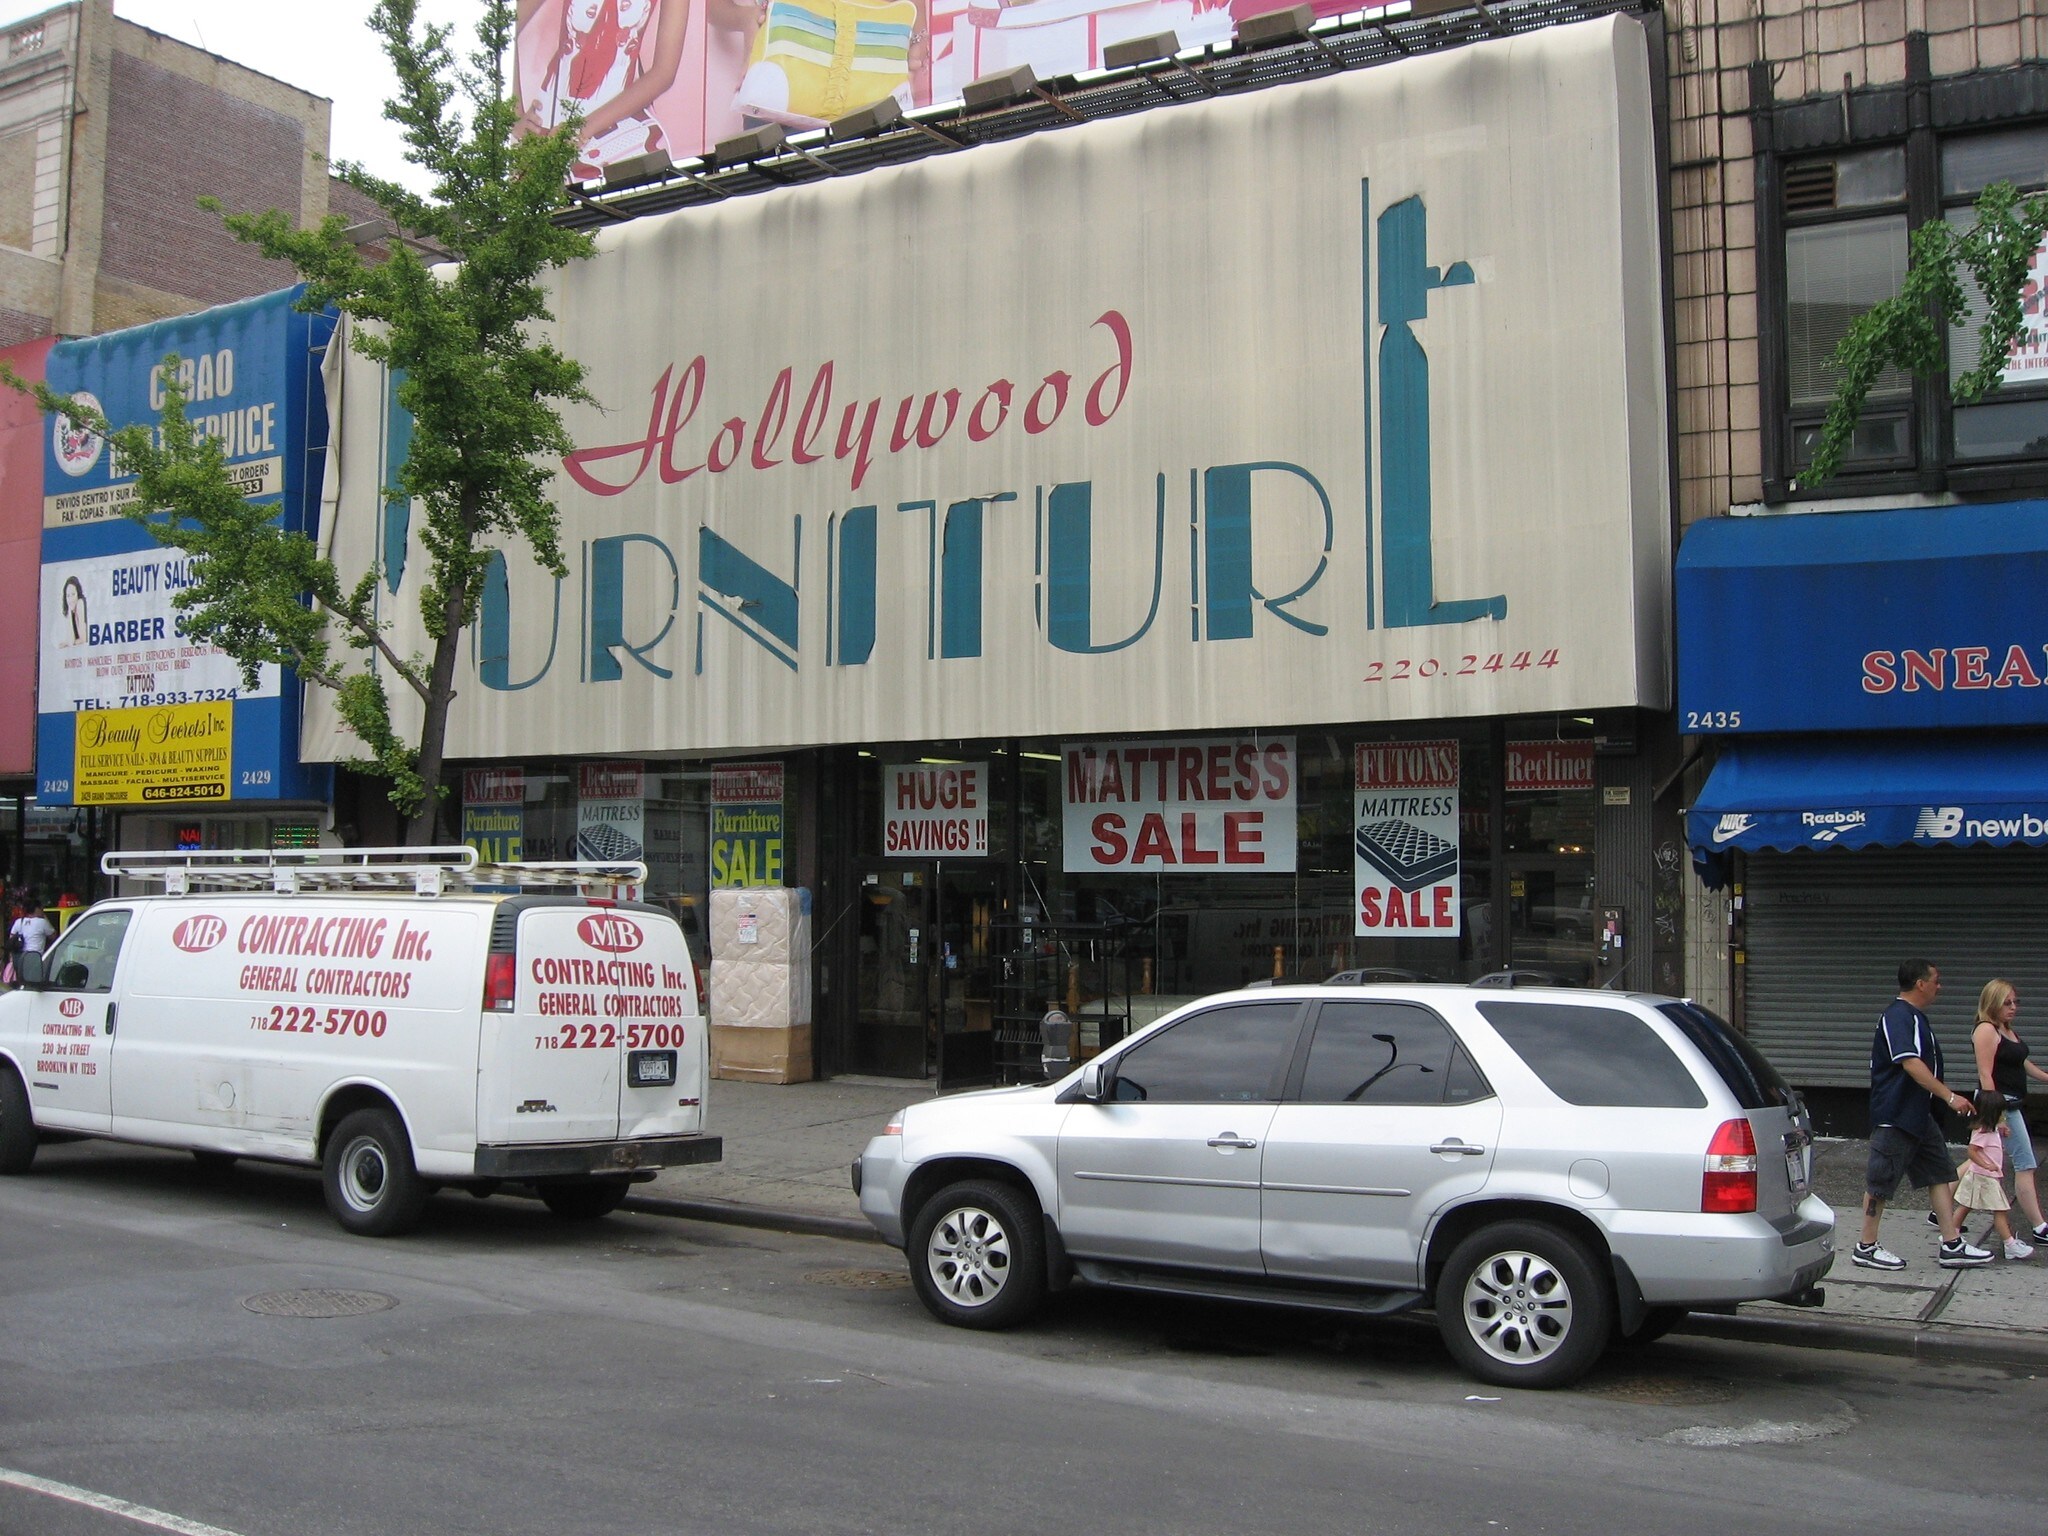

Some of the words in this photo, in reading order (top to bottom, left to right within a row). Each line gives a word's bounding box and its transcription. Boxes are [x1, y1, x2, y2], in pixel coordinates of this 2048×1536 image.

[150, 349, 233, 411] CBAO
[562, 309, 1132, 497] Hollywood
[190, 402, 276, 463] ERVICE
[239, 463, 270, 480] ORDERS
[56, 496, 81, 510] ENVIOS
[82, 492, 109, 507] CENTRO
[110, 491, 115, 502] Y
[116, 488, 131, 501] SUR
[62, 511, 74, 524] FAX
[79, 507, 104, 521] COPIAS
[112, 564, 160, 596] BEAUTY
[89, 617, 165, 646] BARBER
[1363, 648, 1561, 683] 220.2444
[1861, 644, 2048, 694] SNEA
[126, 673, 155, 694] TATTOOS
[73, 698, 111, 712] TEL:
[119, 687, 238, 709] 718-933-7324
[80, 713, 141, 751] Beauty
[148, 708, 207, 744] Secrets
[1687, 711, 1742, 729] 2435
[80, 753, 97, 768] FULL
[98, 752, 125, 768] SERVICE
[126, 751, 145, 767] NAILS
[150, 750, 160, 765] SPA
[168, 748, 195, 764] BEAUTY
[196, 747, 228, 763] SUPPLIES
[135, 768, 178, 776] PEDICURE
[185, 765, 220, 773] WAXING
[1360, 747, 1454, 784] FUTONS
[1508, 750, 1594, 782] Recliner
[162, 774, 226, 783] MULTISERVICE
[242, 770, 271, 785] 2429
[1067, 742, 1291, 804] MATTRESS
[44, 780, 69, 793] 2429
[145, 784, 223, 798] 646-824-5014
[896, 769, 977, 811] HUGE
[581, 804, 641, 822] MATTRESS
[1360, 796, 1454, 818] MATTRESS
[1802, 810, 1867, 827] Reebok
[465, 808, 520, 833] Furniture
[713, 808, 781, 833] Furniture
[1719, 813, 1750, 832] NIKE
[1913, 807, 1964, 839] NB
[886, 819, 970, 852] SAVINGS
[1090, 811, 1266, 865] SALE
[712, 838, 782, 888] SALE
[1360, 886, 1454, 928] SALE
[178, 919, 222, 950] MB
[238, 913, 387, 960] CONTRACTING
[391, 918, 433, 962] Inc.
[587, 918, 638, 948] MB
[239, 966, 298, 993] GENERAL
[305, 967, 411, 999] CONTRACTORS
[531, 957, 655, 988] CONTRACTING
[661, 964, 687, 990] Inc.
[63, 1000, 82, 1015] MB
[538, 992, 597, 1016] GENERAL
[604, 993, 682, 1018] CONTRACTORS
[42, 1023, 82, 1037] CONTRACTING
[85, 1024, 96, 1037] INC.
[250, 1016, 268, 1031] 718
[268, 1005, 388, 1038] 222-5700
[42, 1042, 54, 1055] 230
[57, 1043, 67, 1055] 3rd
[70, 1043, 91, 1056] STREET
[535, 1036, 558, 1050] 718
[560, 1024, 685, 1050] 222-5700
[37, 1060, 68, 1074] BROOKLYN
[70, 1061, 78, 1074] NY
[81, 1062, 97, 1076] 11215
